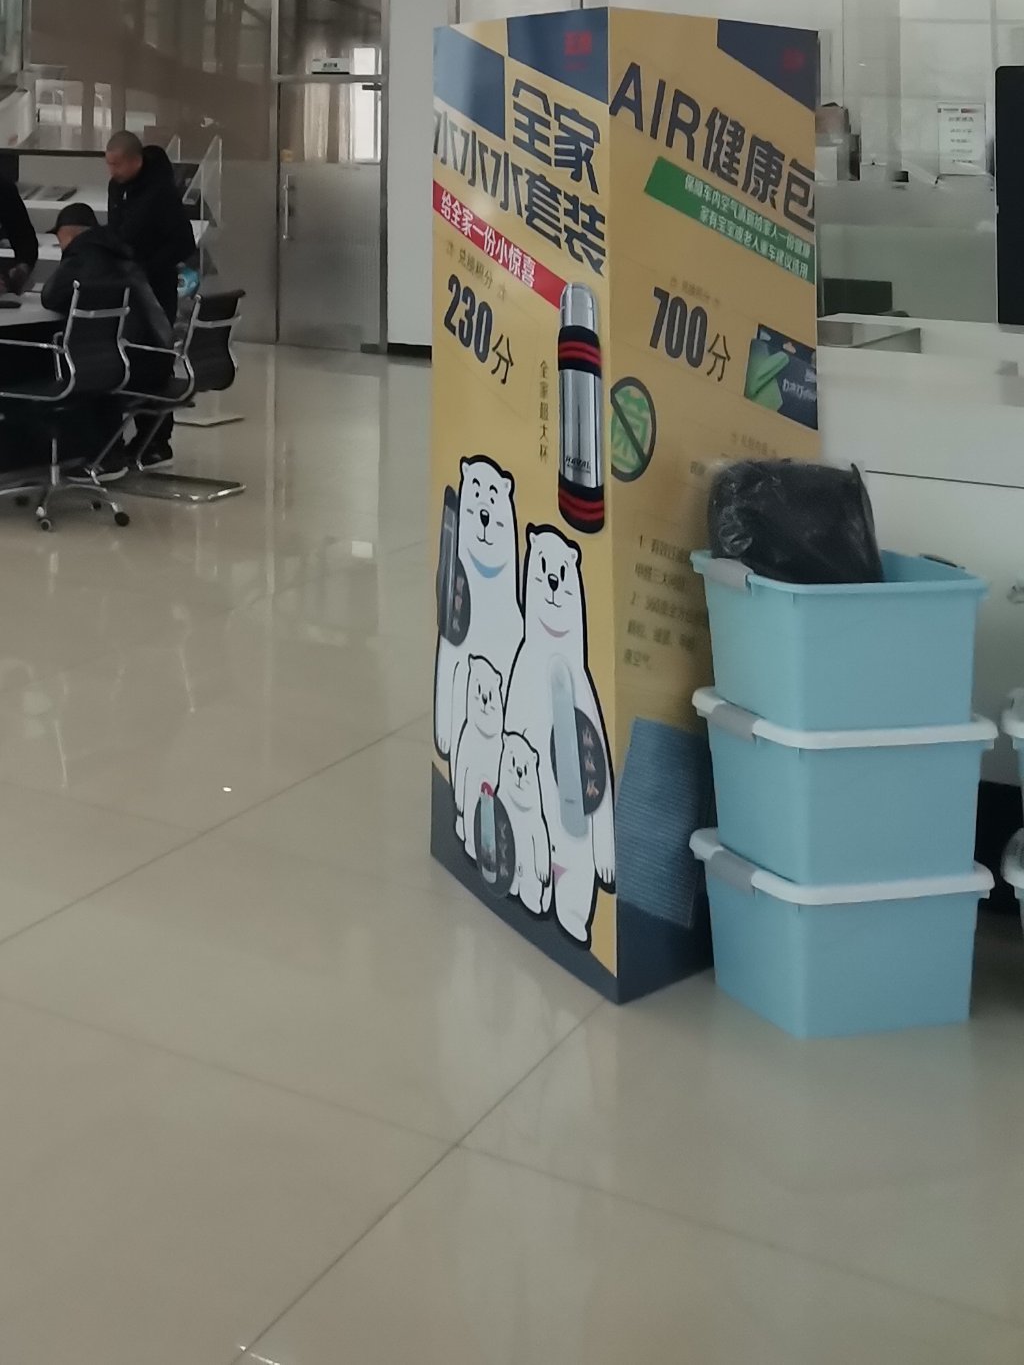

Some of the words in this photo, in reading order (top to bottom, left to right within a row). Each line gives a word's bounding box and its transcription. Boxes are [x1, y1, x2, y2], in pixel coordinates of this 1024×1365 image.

[512, 78, 601, 195] 全家
[609, 62, 815, 233] AIR健康包
[440, 189, 536, 289] 给全家一份小惊喜
[443, 274, 514, 385] 230分
[649, 285, 732, 383] 700分
